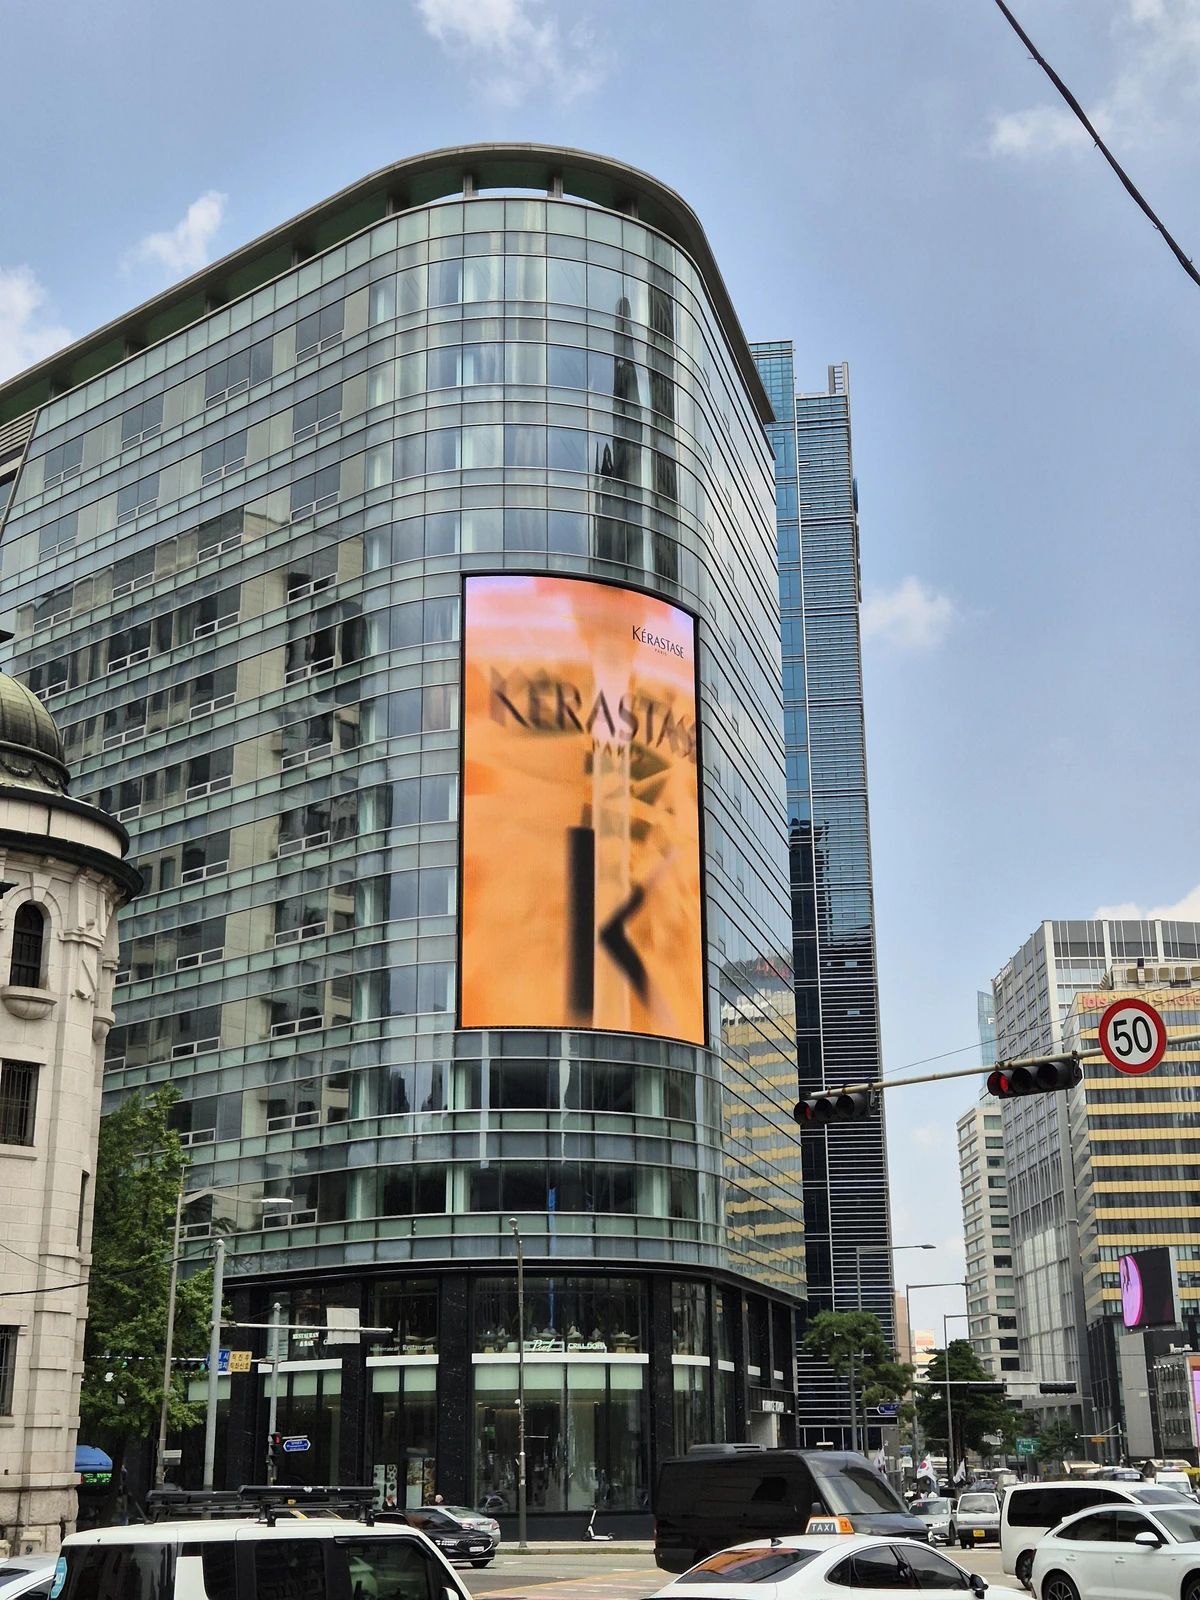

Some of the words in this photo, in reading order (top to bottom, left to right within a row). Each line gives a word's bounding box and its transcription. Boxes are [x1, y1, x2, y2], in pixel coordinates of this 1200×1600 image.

[632, 625, 684, 659] KÉRASTASE
[654, 648, 668, 657] PARIS
[1083, 994, 1107, 1008] ibis
[1113, 1016, 1153, 1057] 50
[402, 1344, 433, 1352] Restaurant
[811, 1524, 834, 1532] TAXI
